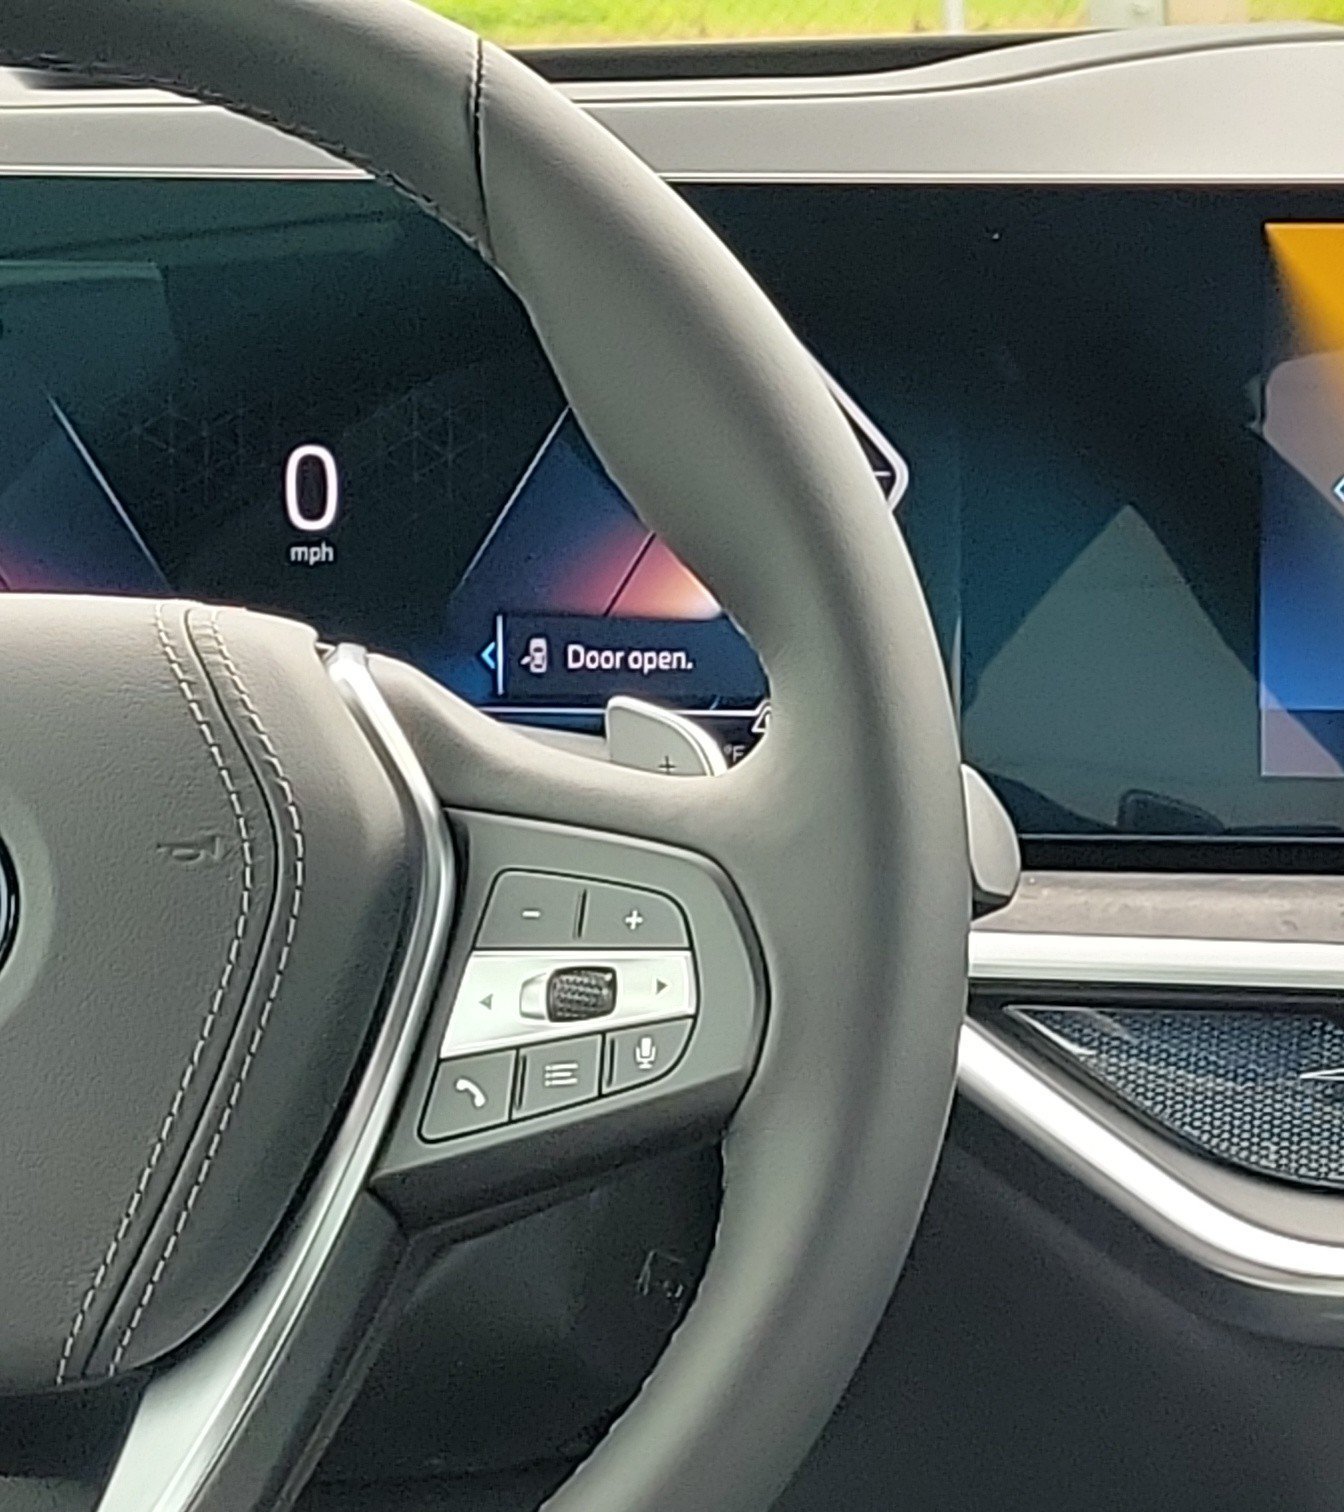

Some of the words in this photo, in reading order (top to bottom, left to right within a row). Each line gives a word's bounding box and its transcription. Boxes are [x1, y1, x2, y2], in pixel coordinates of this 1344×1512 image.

[285, 444, 338, 531] 0
[290, 541, 334, 566] mph
[566, 643, 625, 670] Door
[628, 650, 694, 676] open.
